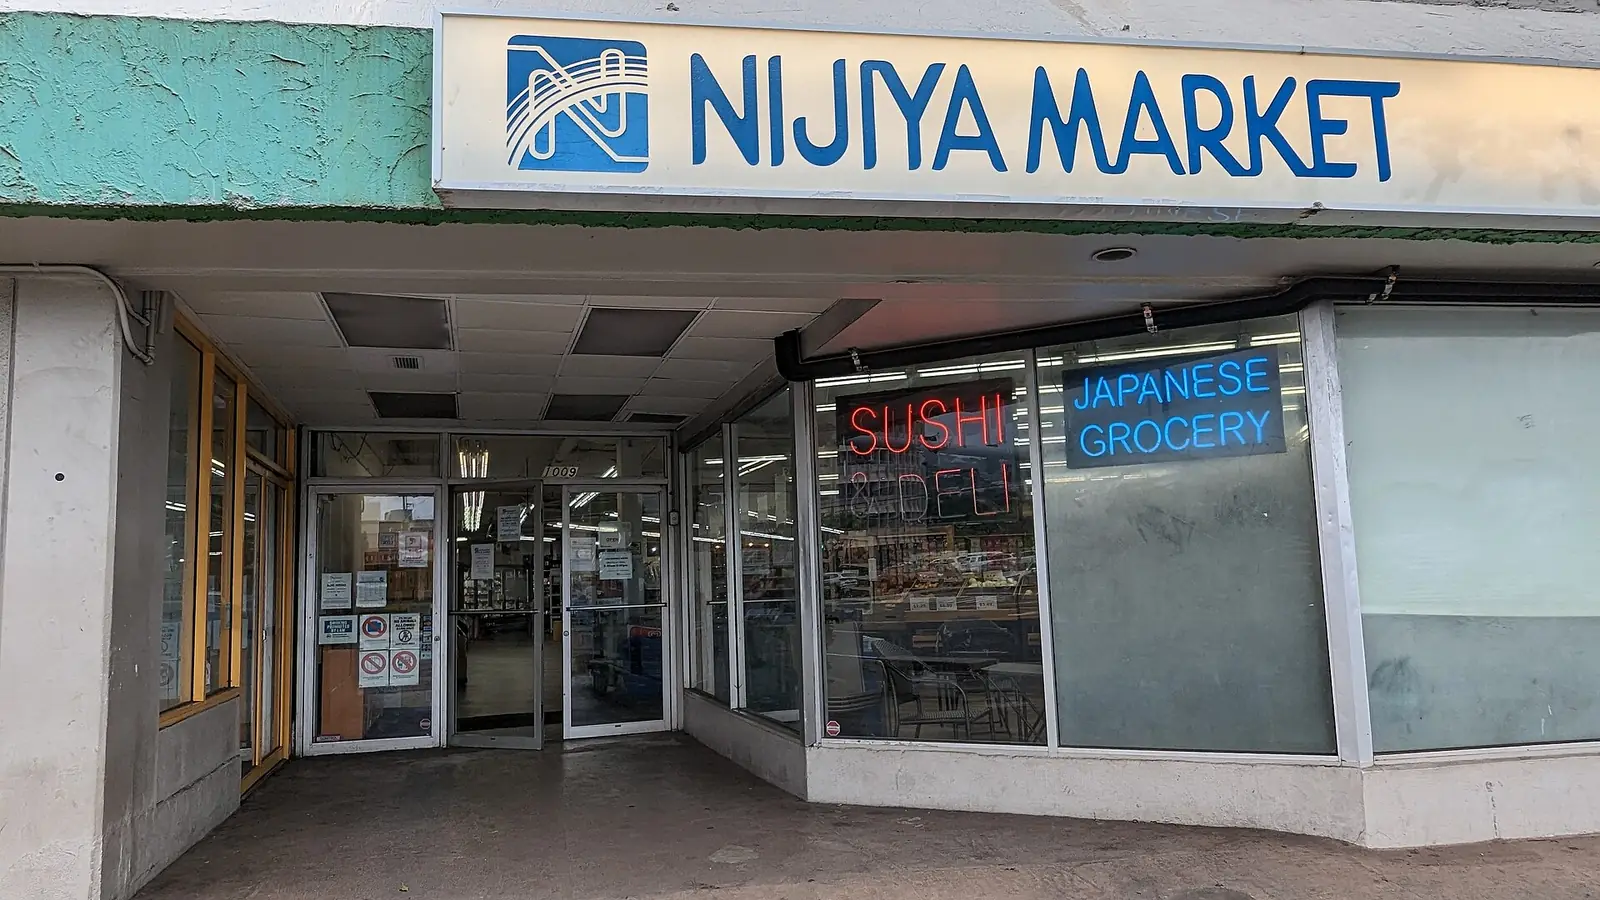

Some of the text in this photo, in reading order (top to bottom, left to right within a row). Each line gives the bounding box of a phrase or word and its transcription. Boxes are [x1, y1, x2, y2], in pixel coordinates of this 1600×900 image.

[690, 53, 1401, 182] NIJIYA MARKET
[1073, 356, 1270, 411] JAPANESE
[850, 394, 1003, 455] SUSHI
[1079, 409, 1271, 458] GROCERY
[544, 466, 577, 478] 1009
[898, 462, 1010, 523] DELI
